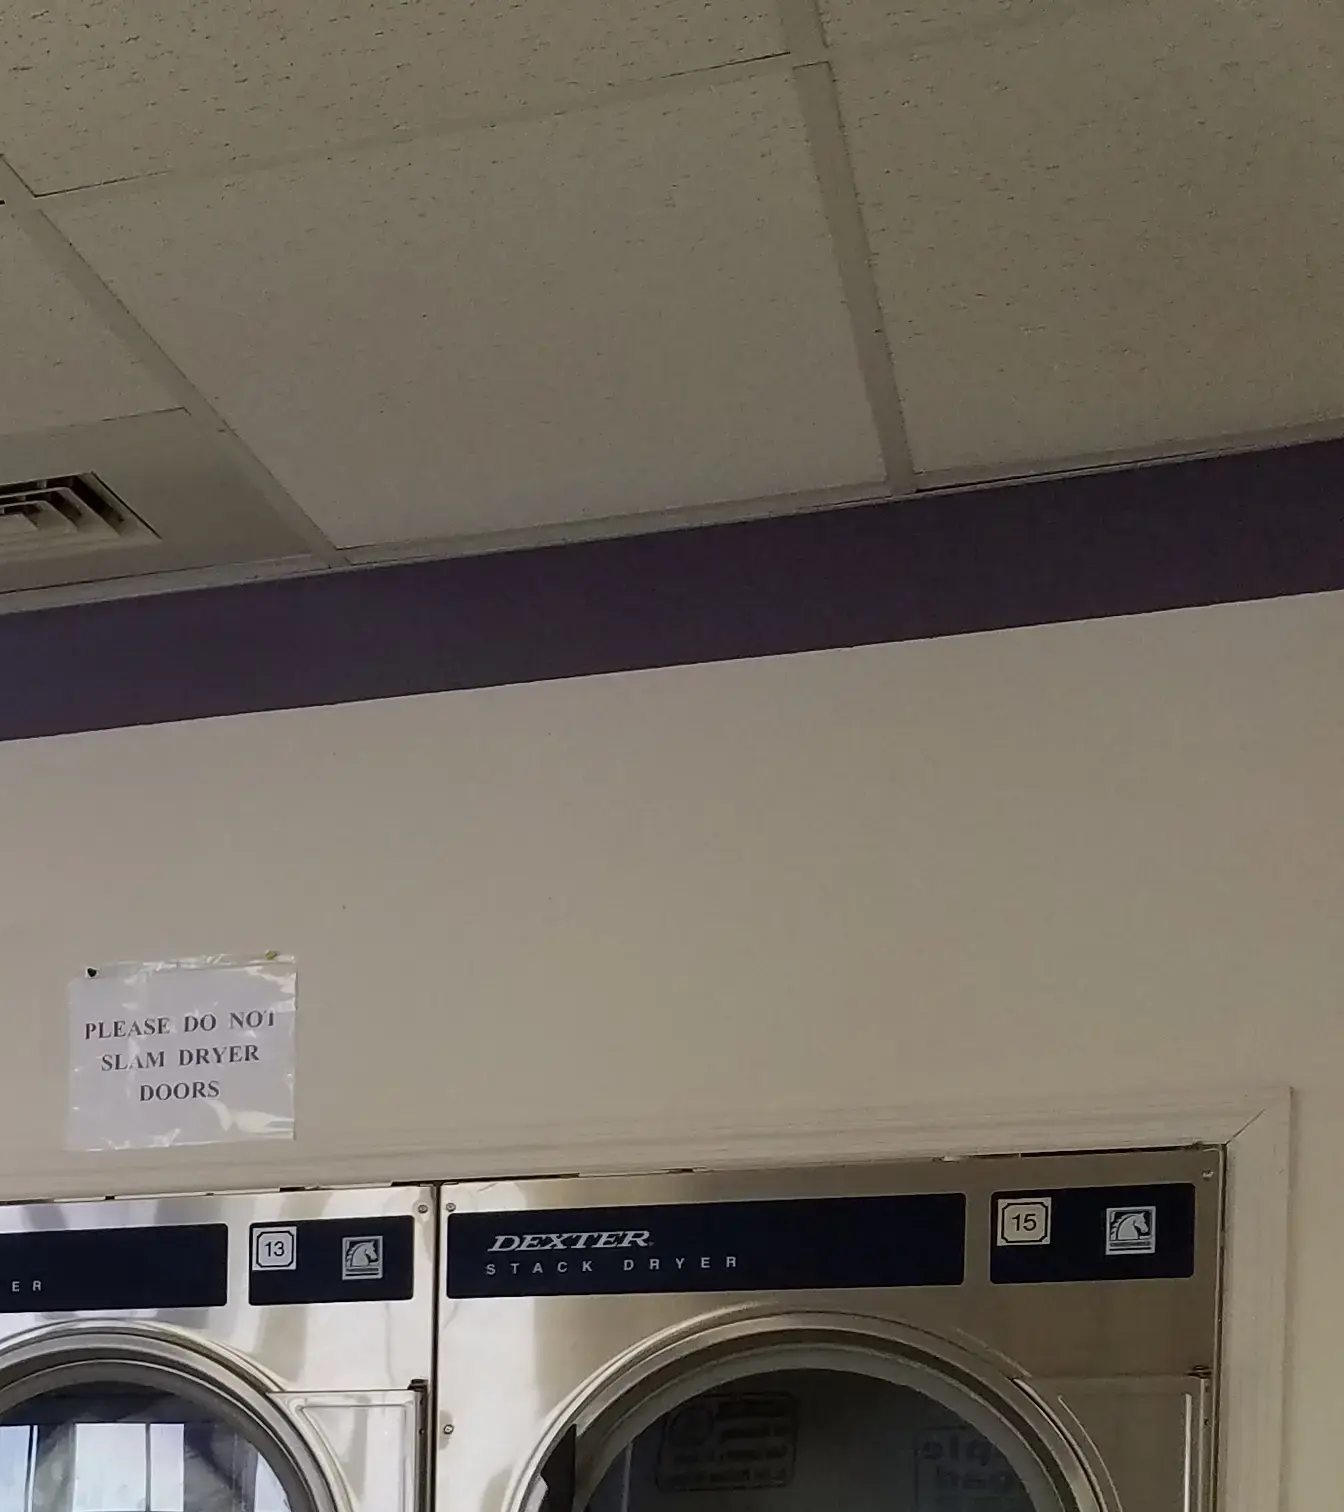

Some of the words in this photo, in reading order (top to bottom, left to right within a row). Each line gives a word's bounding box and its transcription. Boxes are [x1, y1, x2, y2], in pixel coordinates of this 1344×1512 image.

[85, 1017, 170, 1039] PLEASE
[184, 1014, 216, 1032] DO
[229, 1010, 275, 1029] NOT
[101, 1051, 165, 1071] SLAM
[179, 1044, 259, 1066] DRYER
[140, 1081, 220, 1101] DOORS
[1012, 1213, 1037, 1232] 15
[264, 1240, 285, 1258] 13
[487, 1230, 652, 1252] DEXTER
[486, 1261, 593, 1276] STACK
[623, 1256, 738, 1271] DRYER
